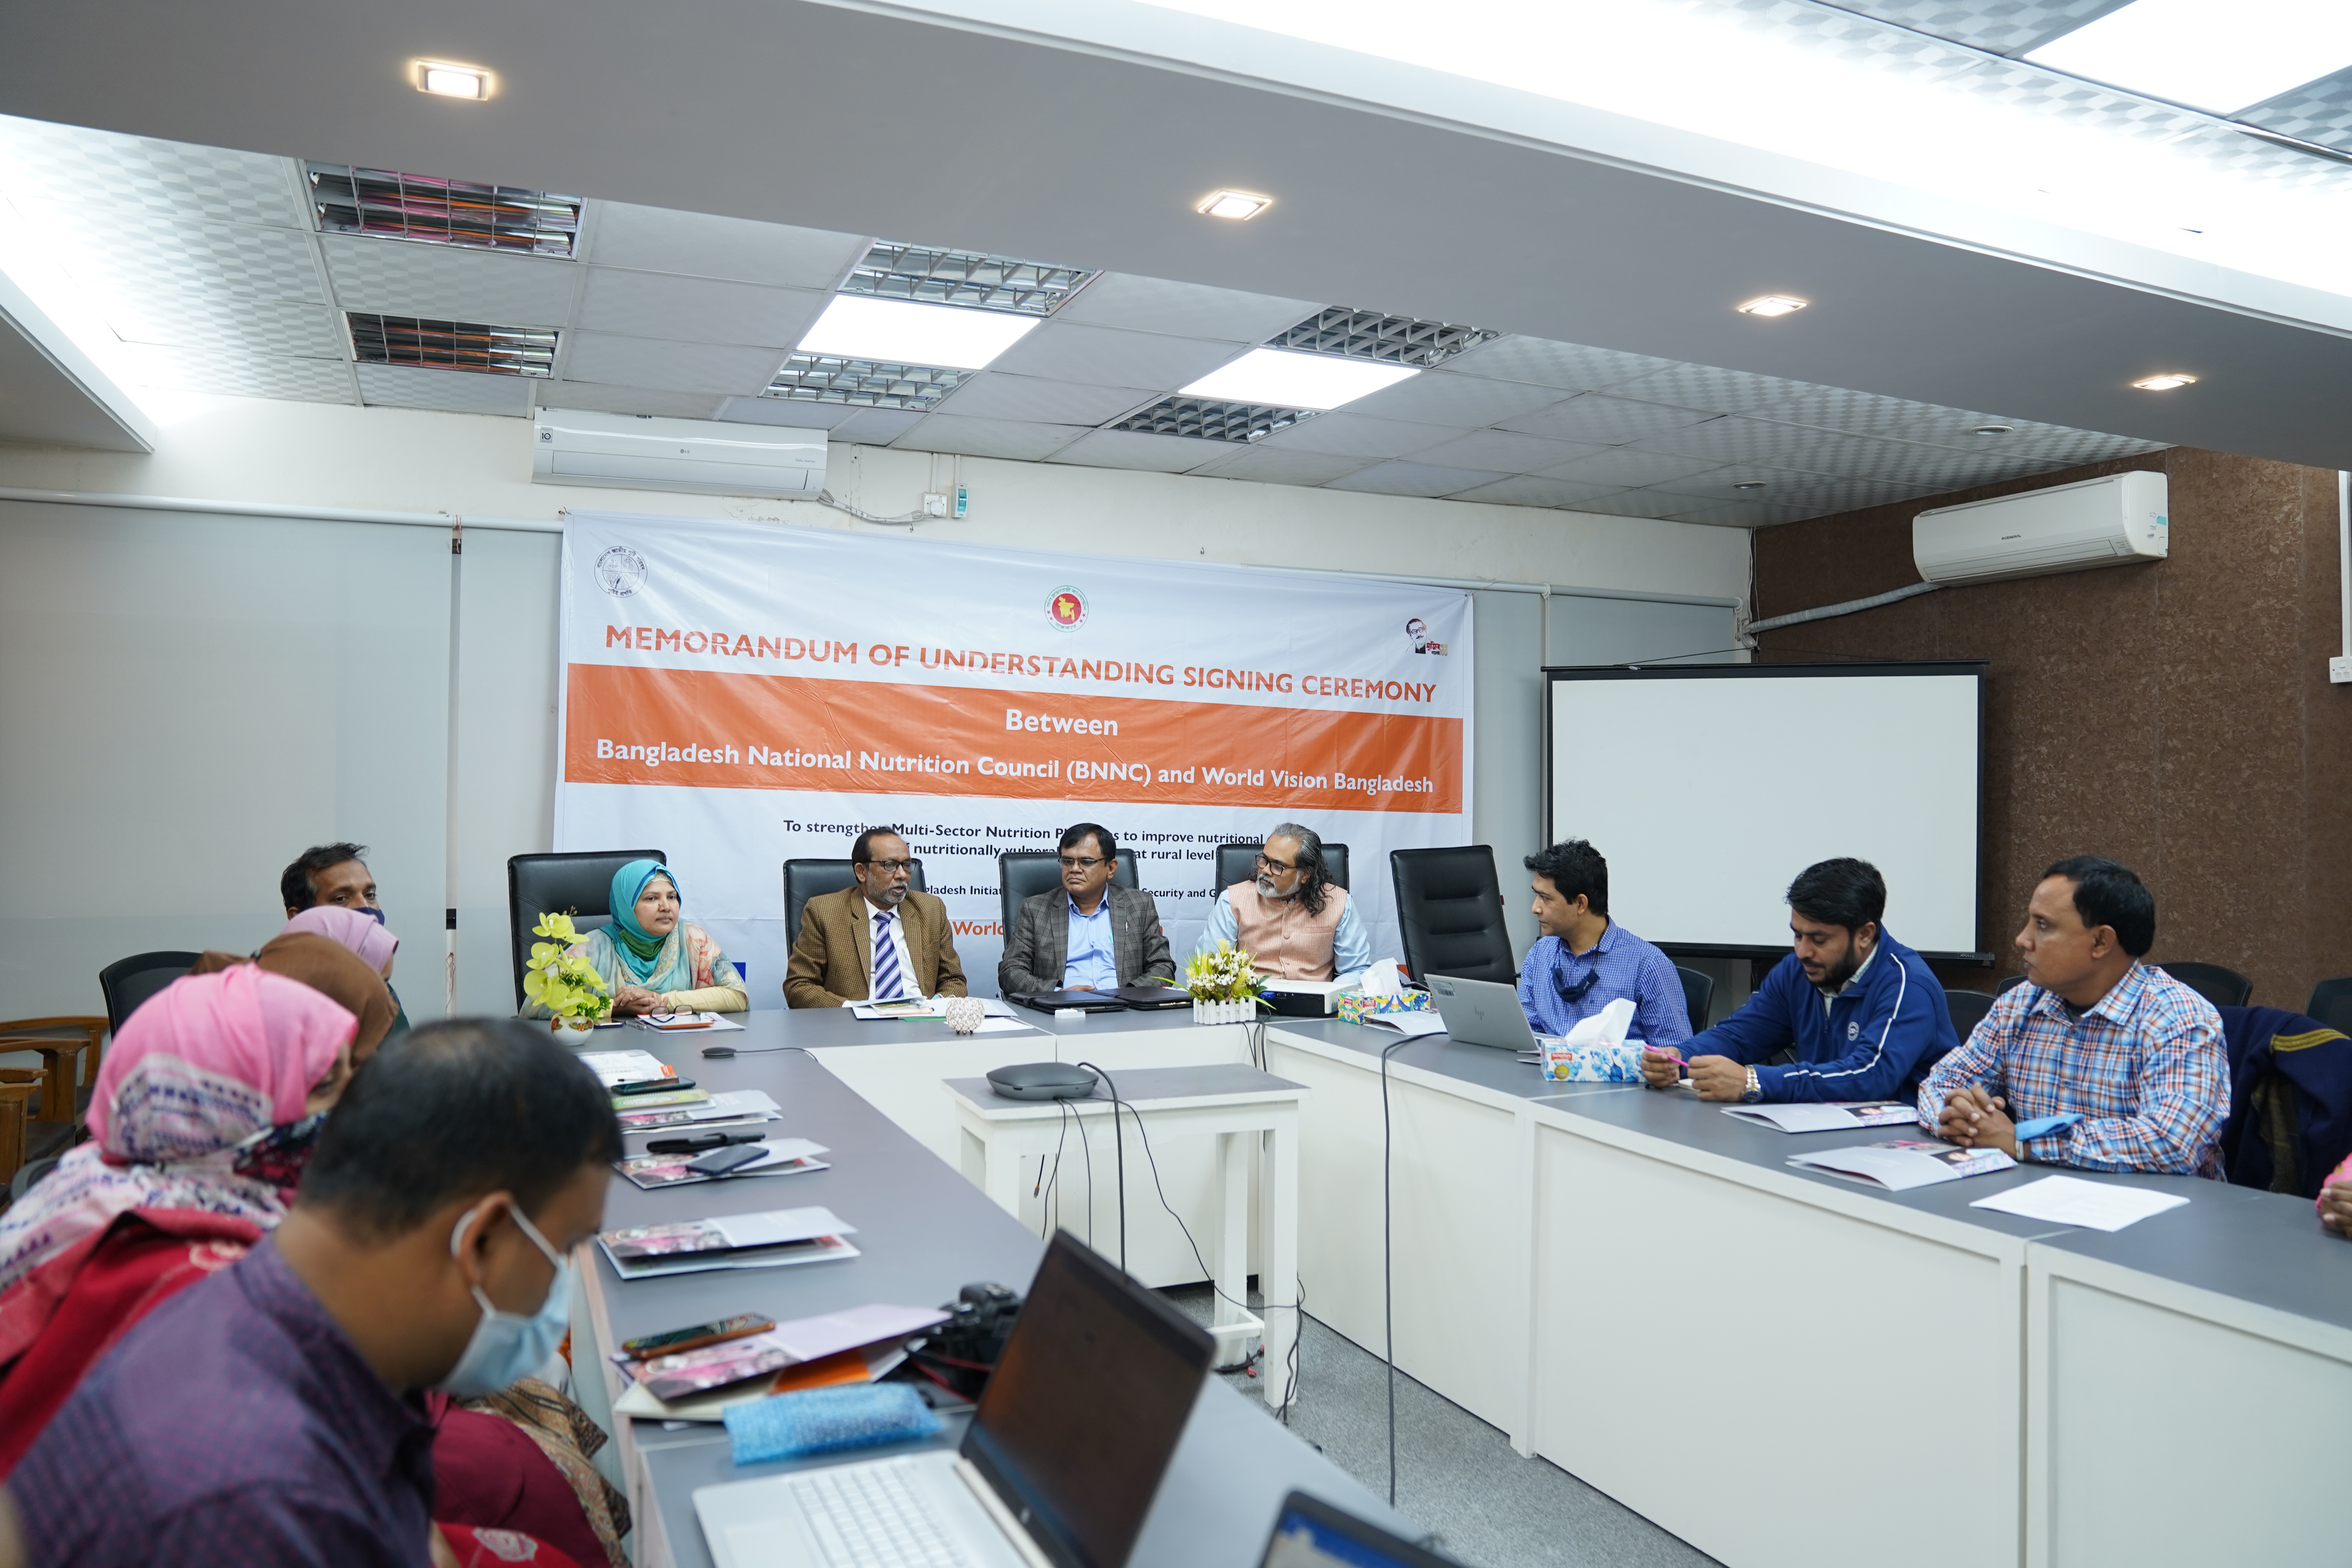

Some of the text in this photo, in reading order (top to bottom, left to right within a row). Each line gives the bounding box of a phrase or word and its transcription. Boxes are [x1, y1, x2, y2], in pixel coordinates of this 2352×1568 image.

[606, 625, 1436, 702] MEMORANDUM OF UNDERSTANDING SIGNING CEREMONY
[1006, 709, 1118, 736] Between
[597, 739, 1434, 796] Bangladesh National Nutrition Council (BNNC) and World Vision Bangladesh
[783, 820, 801, 831] To
[892, 823, 981, 837] Multi-Sector
[986, 826, 1050, 838] Nutrition
[1123, 831, 1138, 840] to
[1142, 831, 1194, 845] improve
[1198, 833, 1263, 844] nutritional
[914, 844, 1001, 859] nutritionally
[1151, 849, 1181, 859] rural
[1187, 849, 1214, 860] level
[1187, 889, 1205, 897] and
